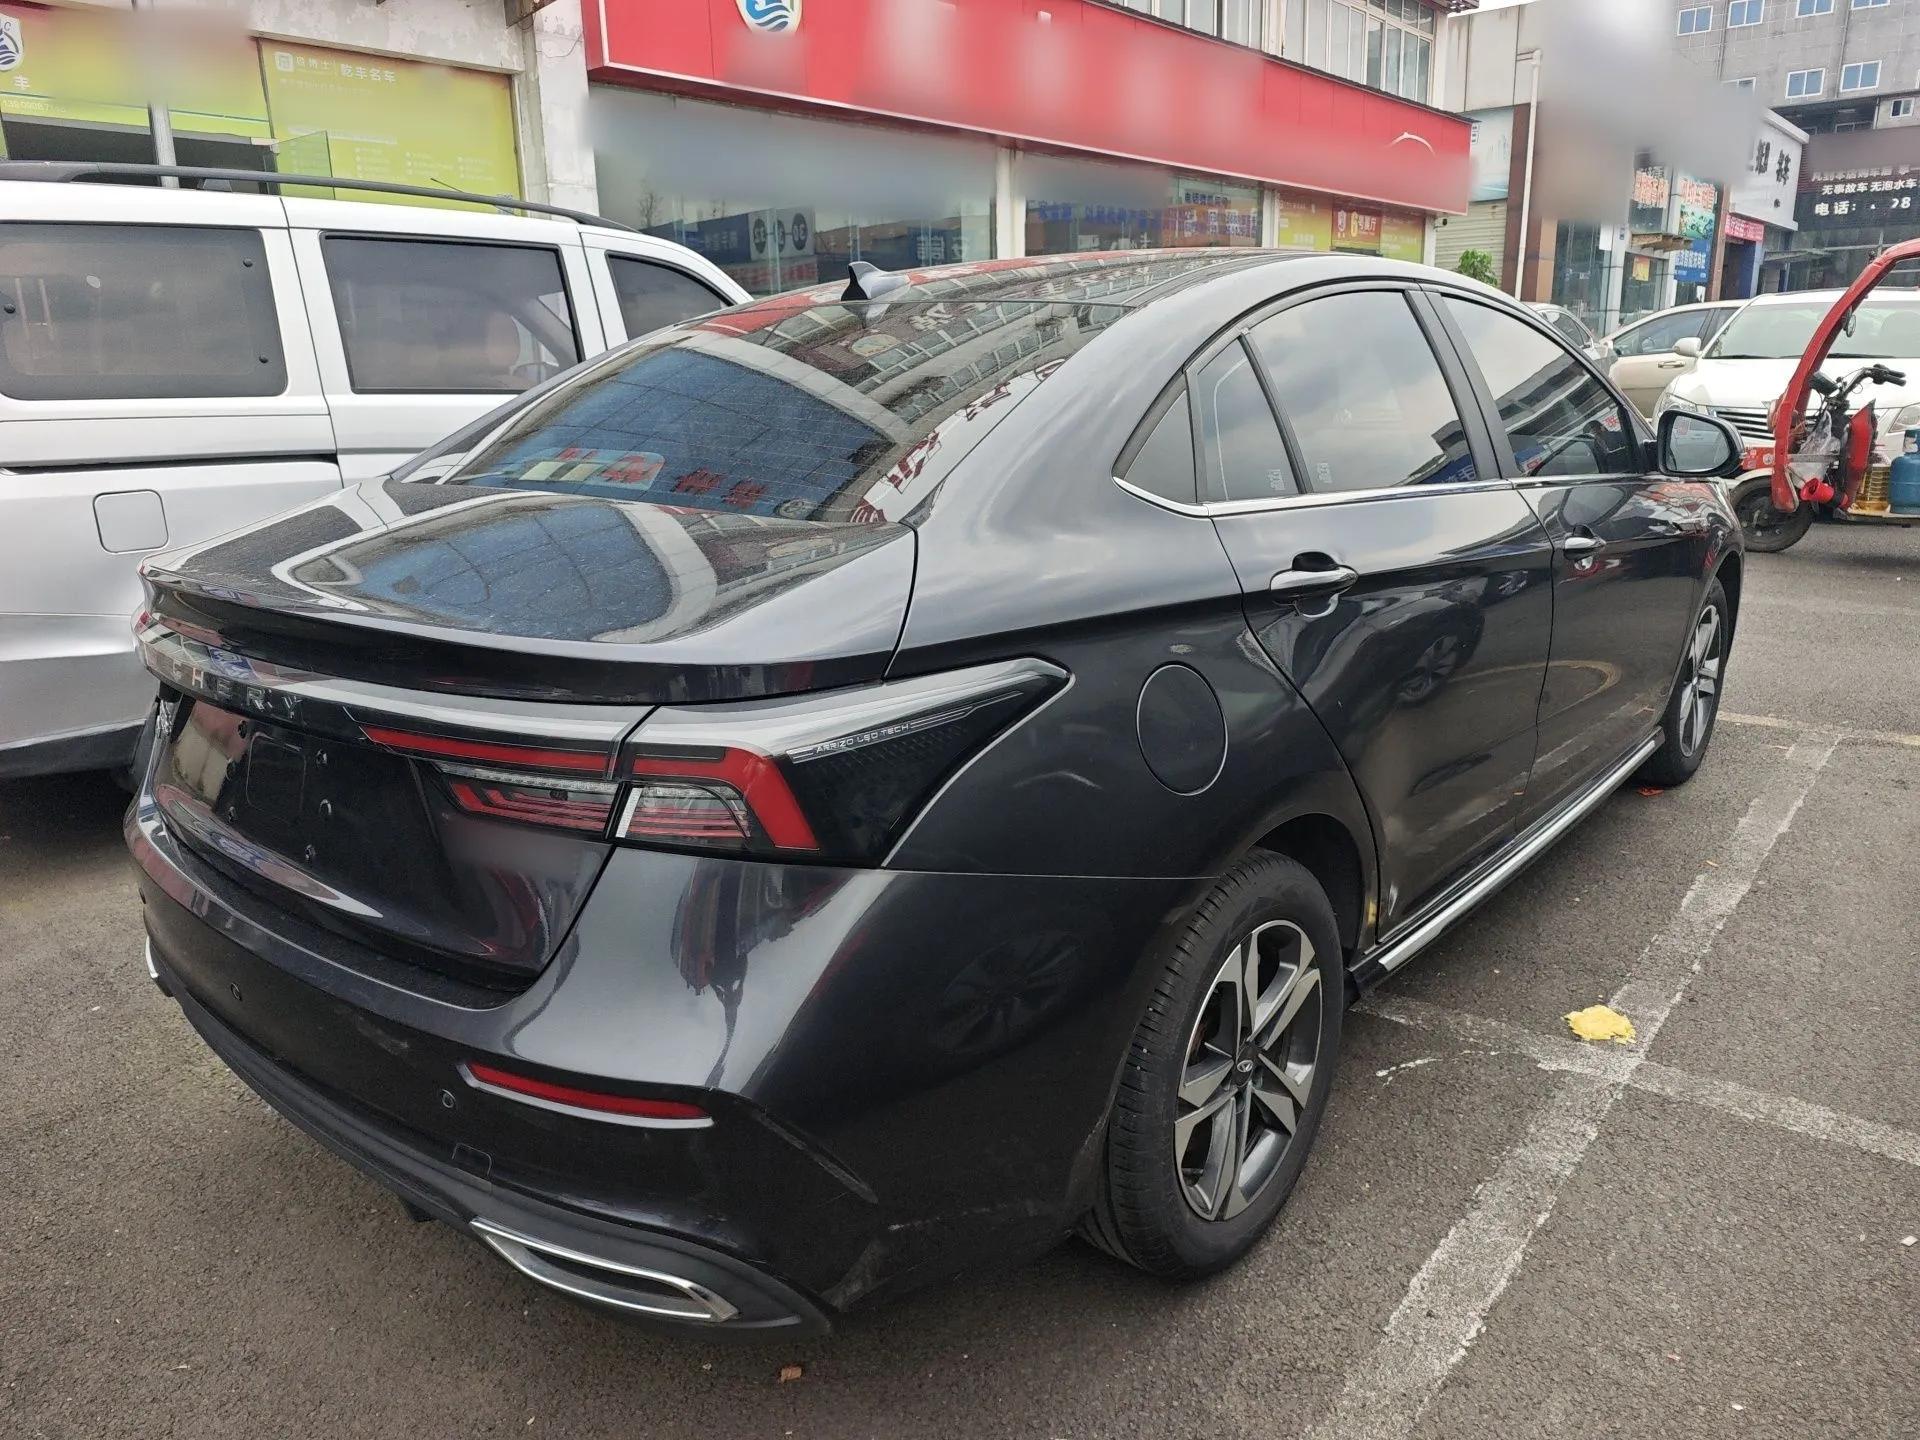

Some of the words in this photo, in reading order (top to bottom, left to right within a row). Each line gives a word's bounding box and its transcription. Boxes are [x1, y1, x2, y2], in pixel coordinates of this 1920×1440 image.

[1822, 182, 1869, 195] 无事故车
[1870, 178, 1918, 192] 无泡水车
[816, 737, 854, 754] ARRIZO
[881, 723, 909, 737] TECH
